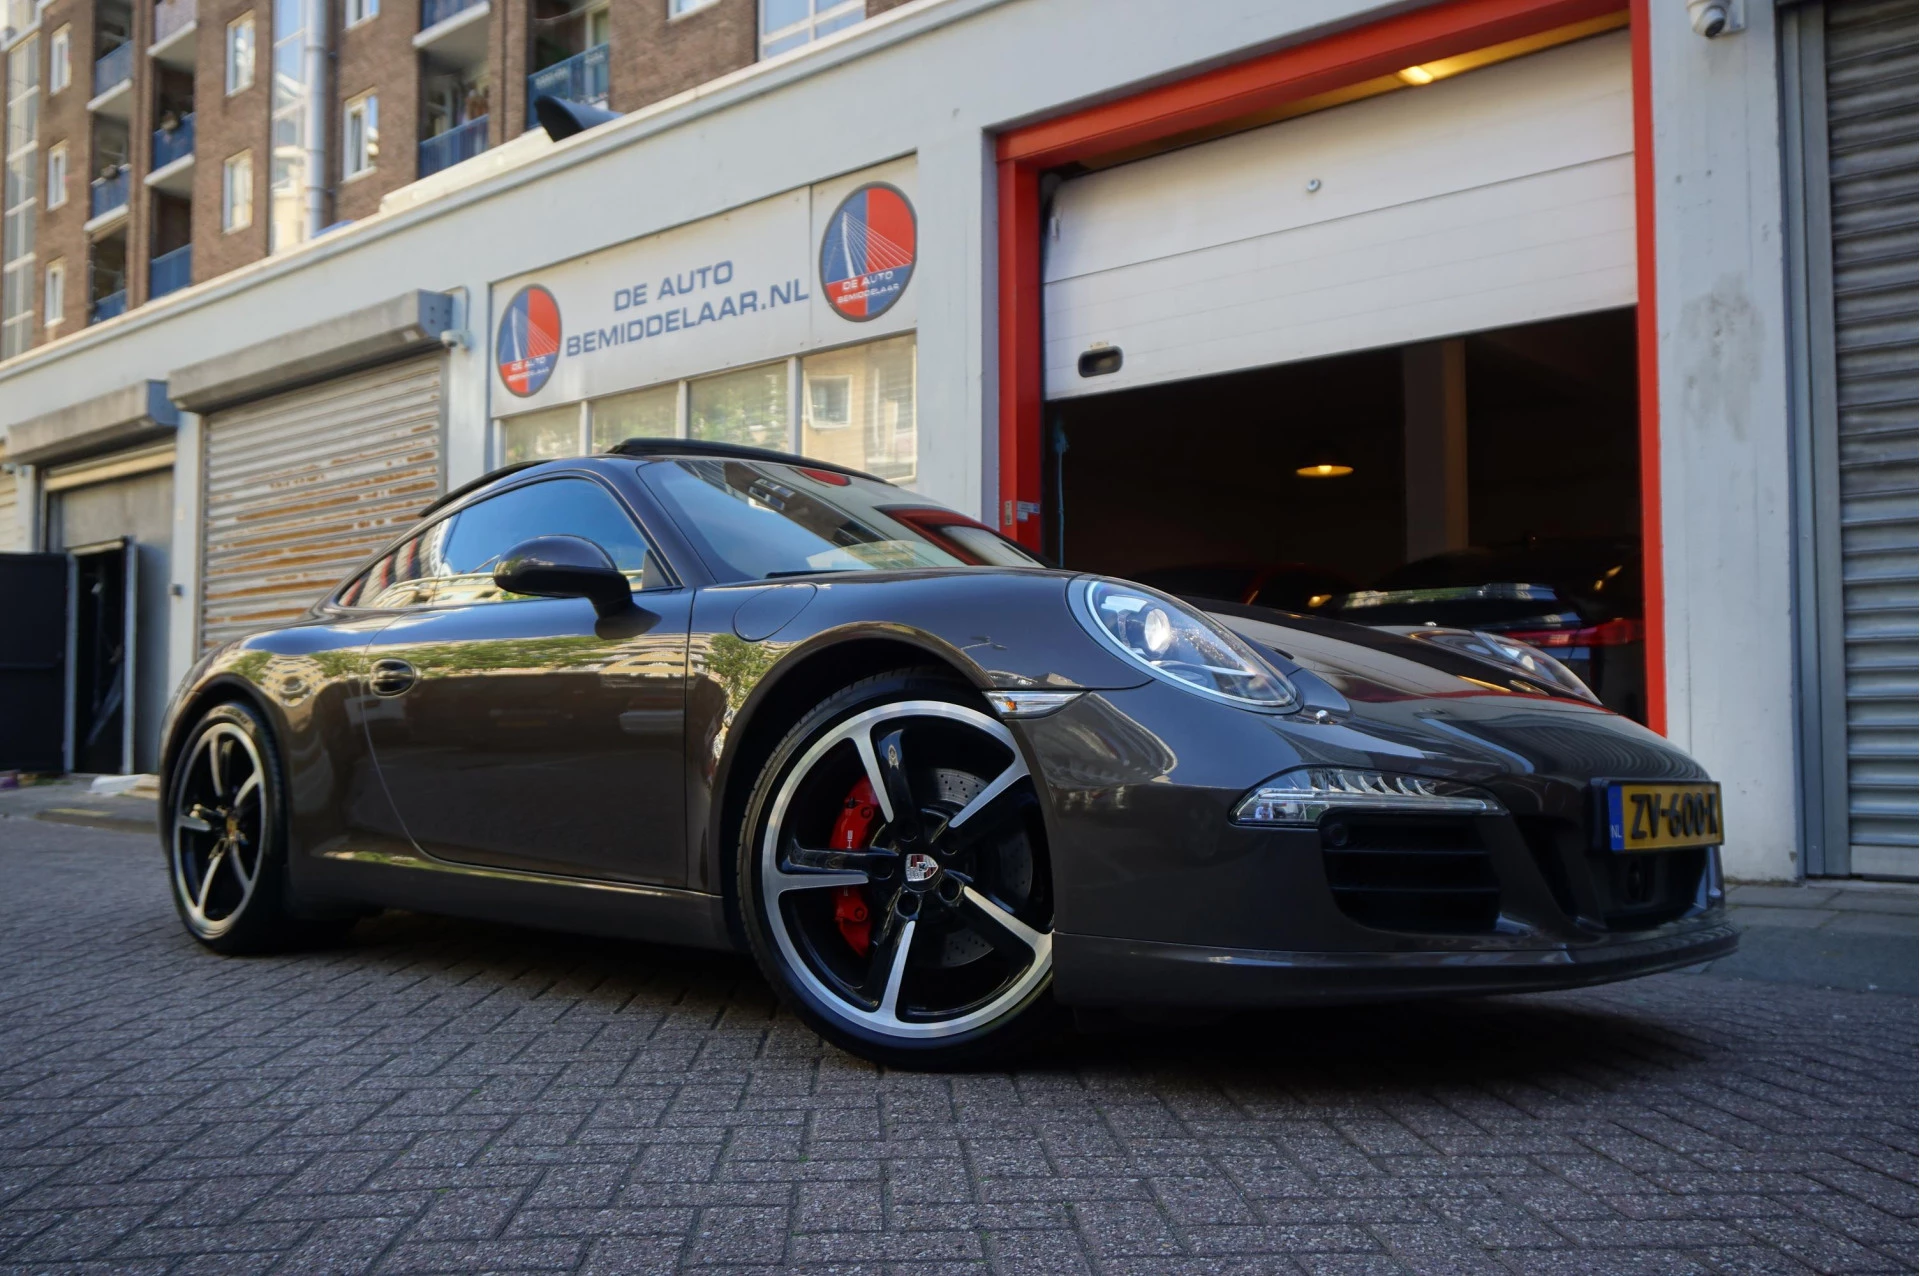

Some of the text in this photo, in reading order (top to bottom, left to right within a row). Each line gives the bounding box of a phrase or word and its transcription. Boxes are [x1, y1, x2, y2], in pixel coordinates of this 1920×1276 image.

[614, 260, 733, 311] DE AUTO
[843, 271, 893, 290] DE AUTO
[566, 278, 809, 357] BEMIDDELAAR.NL
[1610, 825, 1622, 838] NL
